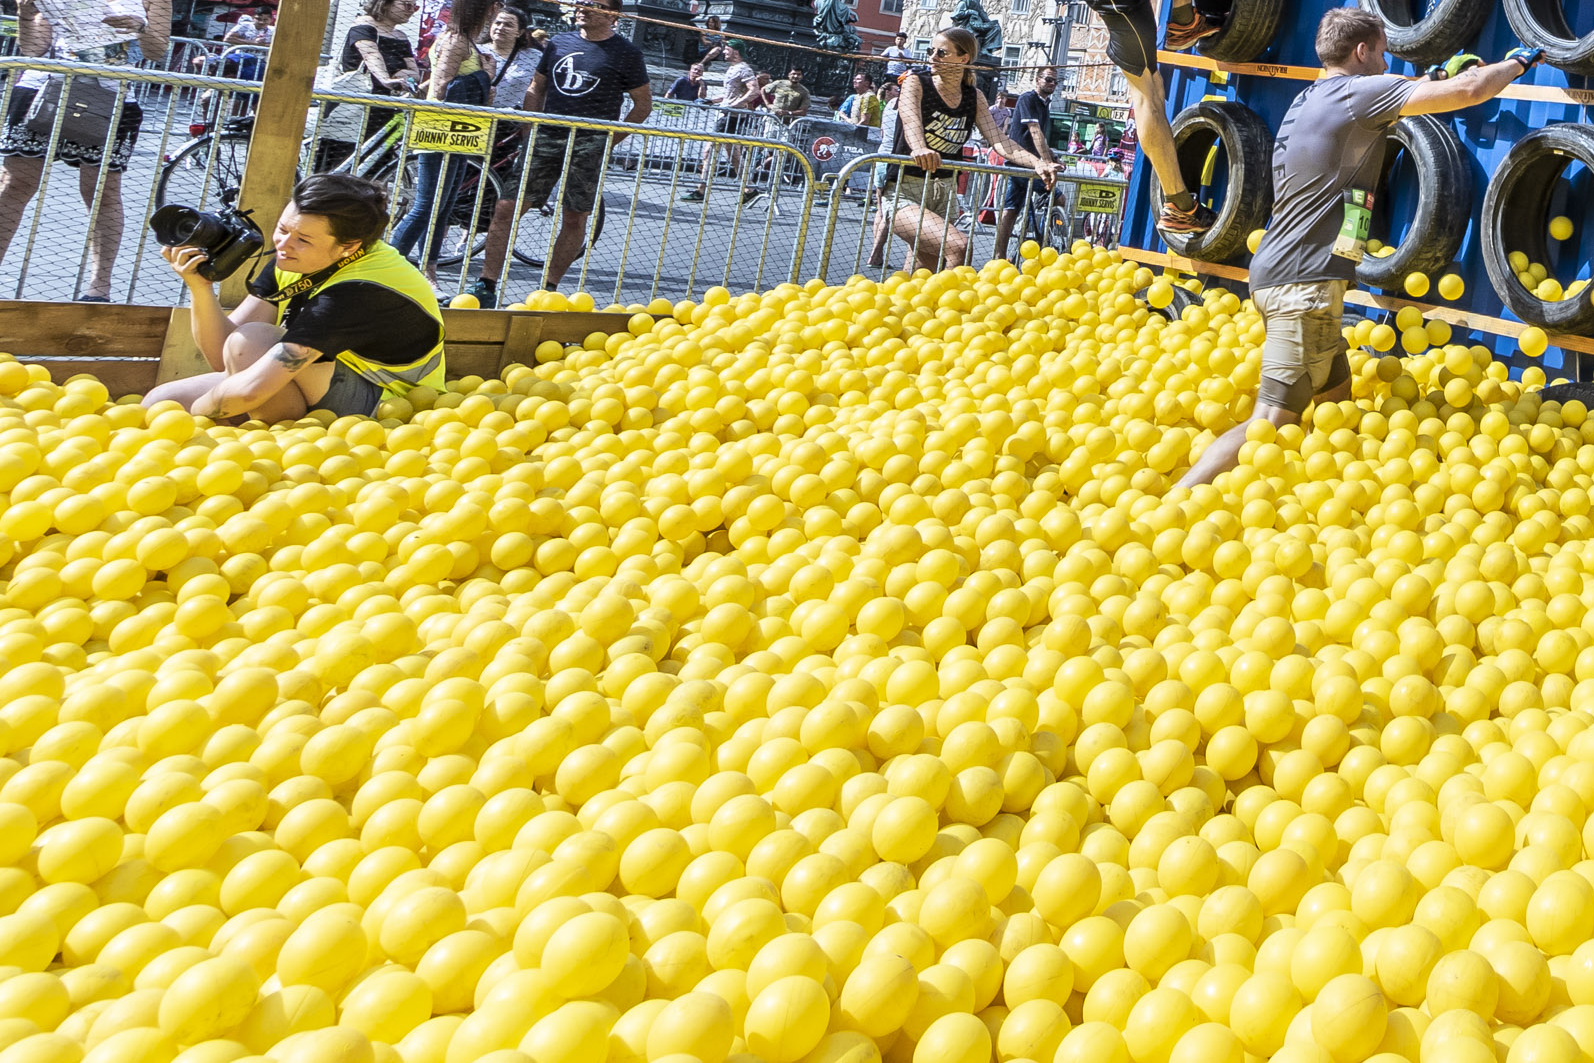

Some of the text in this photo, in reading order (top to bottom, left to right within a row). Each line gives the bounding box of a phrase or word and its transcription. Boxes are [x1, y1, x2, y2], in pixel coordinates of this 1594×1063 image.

[413, 129, 480, 148] JOHNNY SERVIS
[337, 248, 365, 269] Nikon
